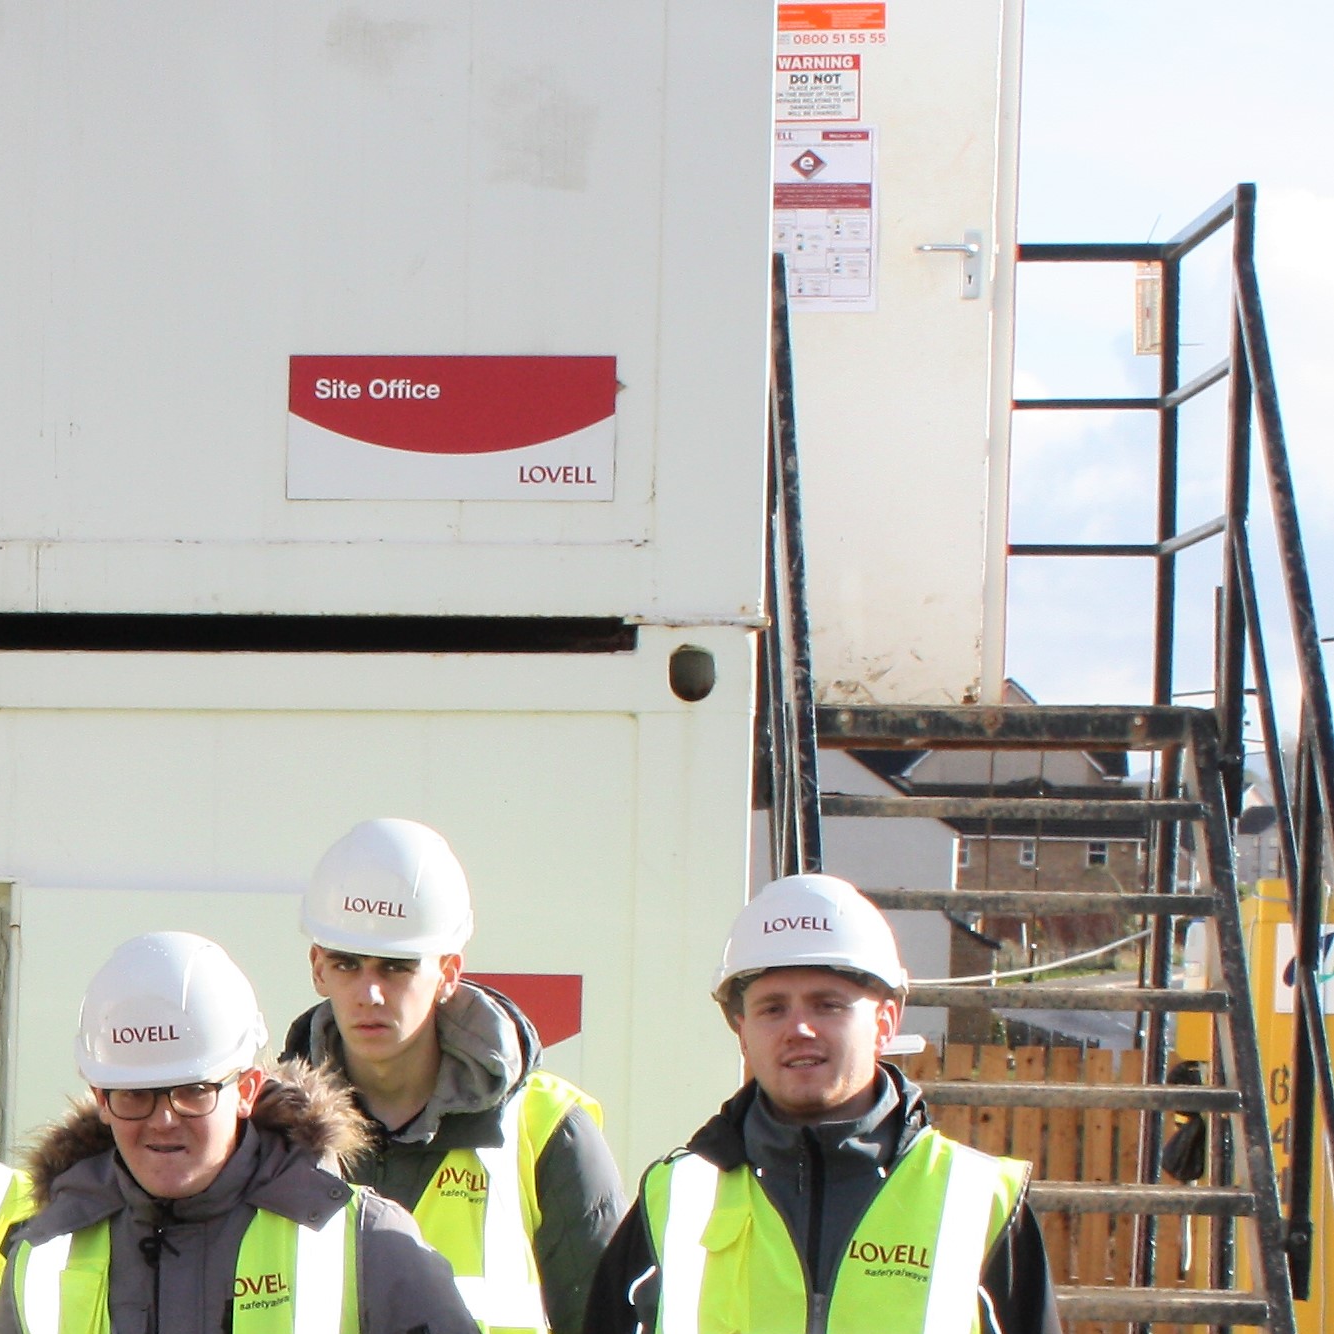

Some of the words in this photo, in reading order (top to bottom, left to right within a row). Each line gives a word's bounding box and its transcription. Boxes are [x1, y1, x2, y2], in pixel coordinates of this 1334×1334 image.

[793, 33, 829, 44] 0800
[832, 33, 846, 44] 51
[849, 33, 867, 44] 55
[869, 33, 886, 44] 55
[777, 55, 854, 69] WARNING
[789, 74, 809, 85] DO
[813, 73, 842, 84] NOT
[314, 378, 361, 400] Site
[368, 378, 441, 400] Office
[518, 465, 597, 484] LOVELL
[343, 896, 407, 919] LOVELL
[762, 917, 834, 935] LOVELL
[112, 1025, 180, 1045] LOVELL
[849, 1240, 930, 1269] LOVELL
